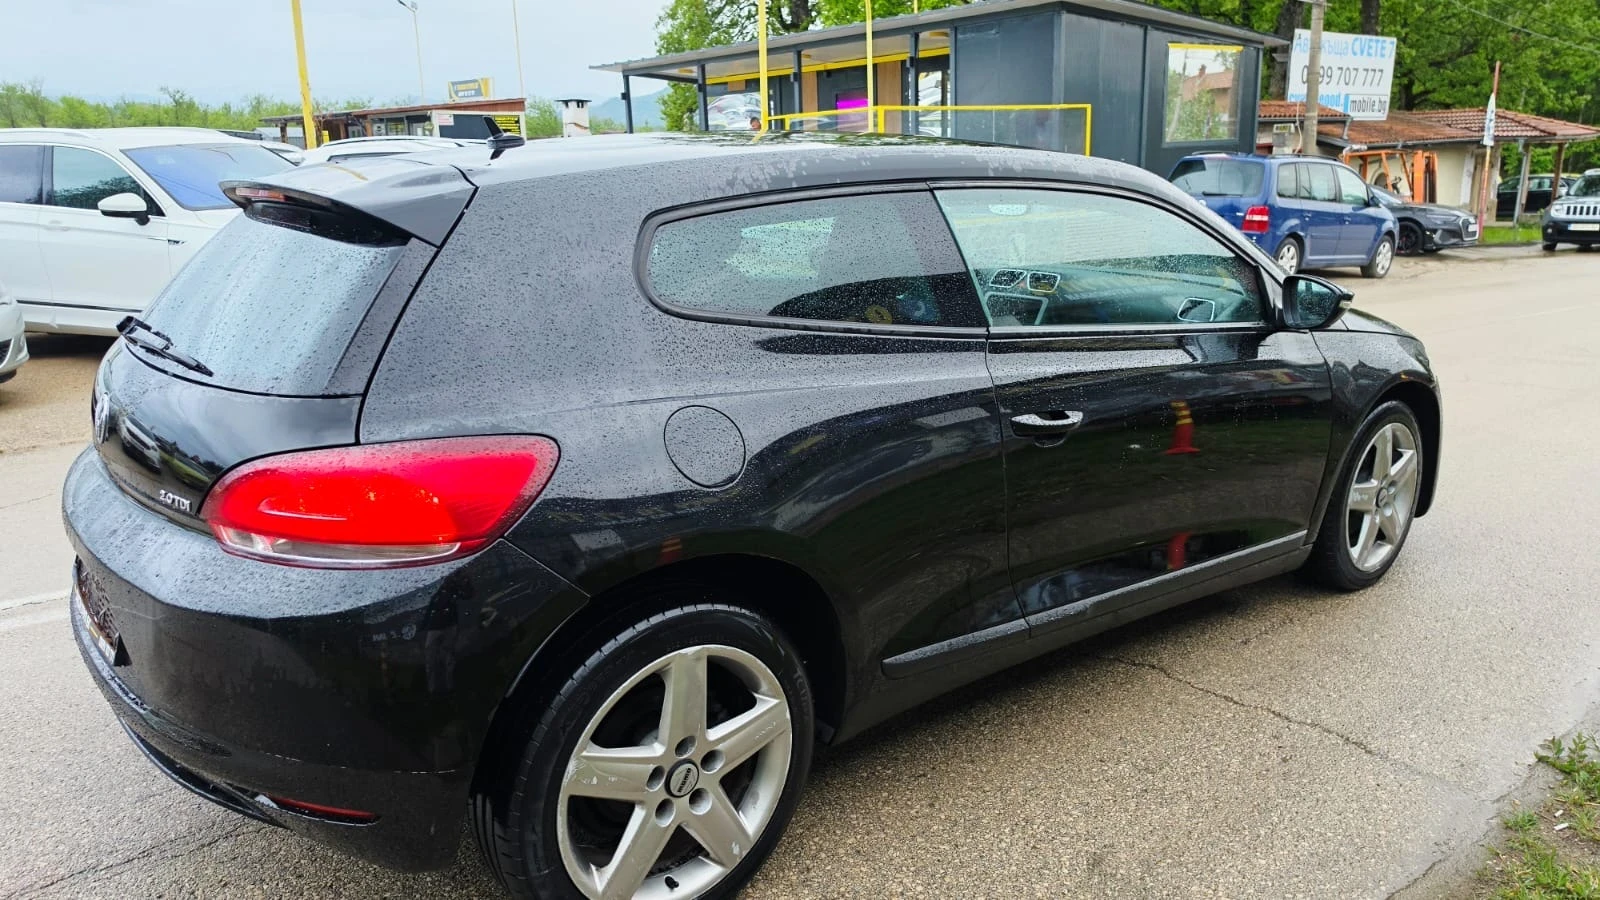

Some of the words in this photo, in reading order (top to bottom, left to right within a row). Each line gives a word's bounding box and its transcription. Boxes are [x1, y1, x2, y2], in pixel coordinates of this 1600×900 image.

[1351, 37, 1386, 58] CVETE
[1388, 41, 1395, 58] 7
[1301, 65, 1333, 85] 099
[1336, 66, 1359, 87] 707
[1362, 68, 1384, 87] 777
[1350, 98, 1387, 115] mobile.bg
